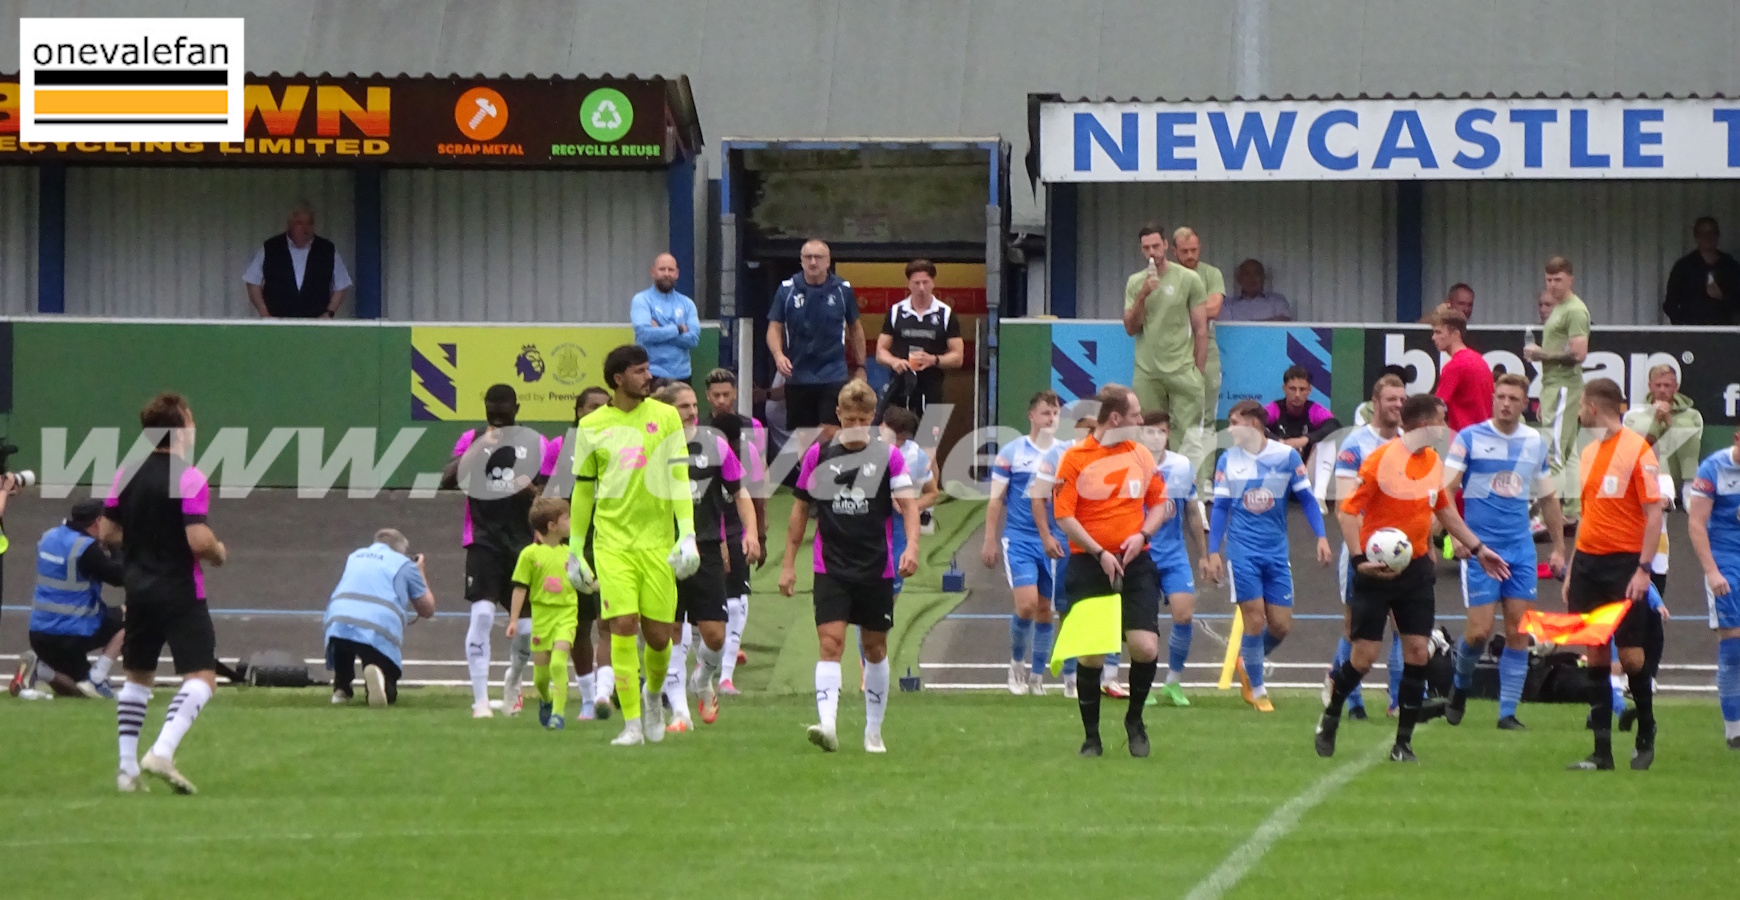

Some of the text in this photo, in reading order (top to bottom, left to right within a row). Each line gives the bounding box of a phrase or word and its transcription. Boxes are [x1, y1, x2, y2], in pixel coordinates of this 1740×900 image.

[1073, 107, 1665, 171] NEWCASTLE
[219, 138, 390, 155] LIMITED
[437, 143, 525, 156] SCRAP METAL
[552, 144, 661, 156] RECYCLE & REUSE
[548, 391, 579, 401] Premi
